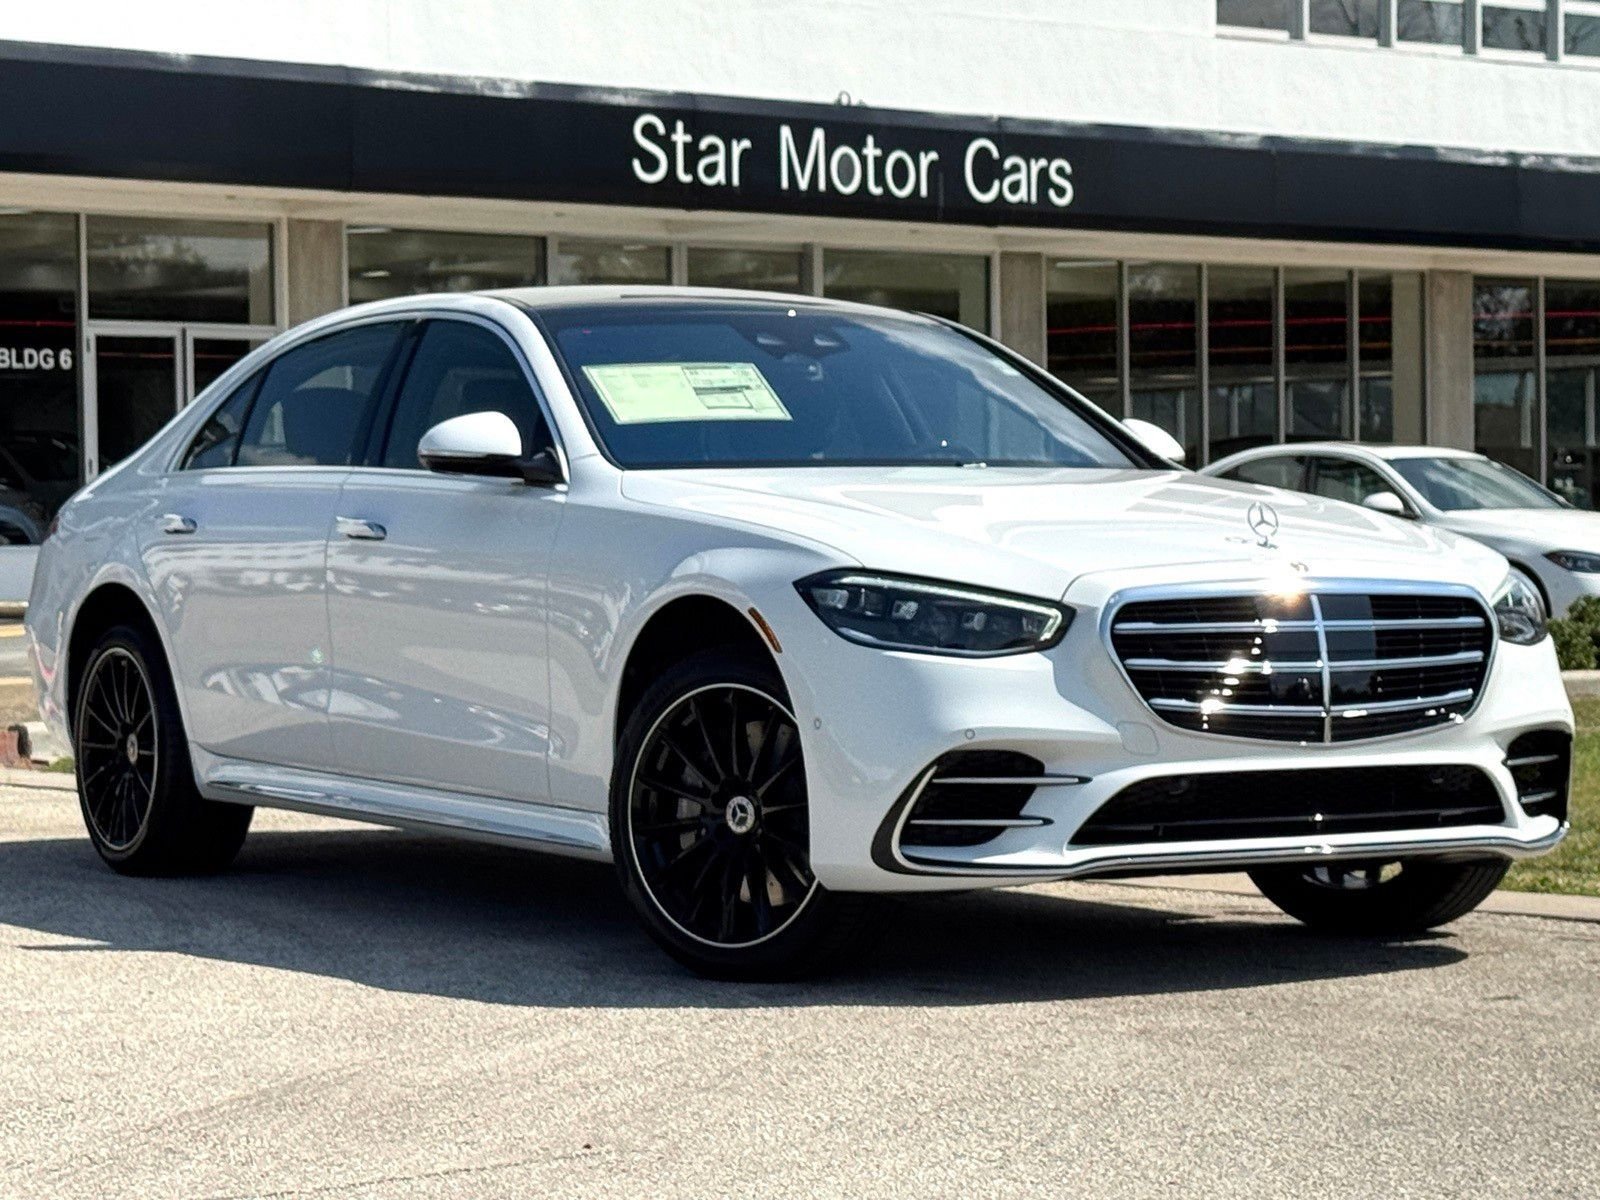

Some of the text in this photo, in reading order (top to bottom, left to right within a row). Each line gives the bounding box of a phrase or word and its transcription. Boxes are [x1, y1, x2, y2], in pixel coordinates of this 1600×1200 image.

[631, 113, 1075, 208] Star Motor Cars
[0, 347, 73, 370] BLDG 6
